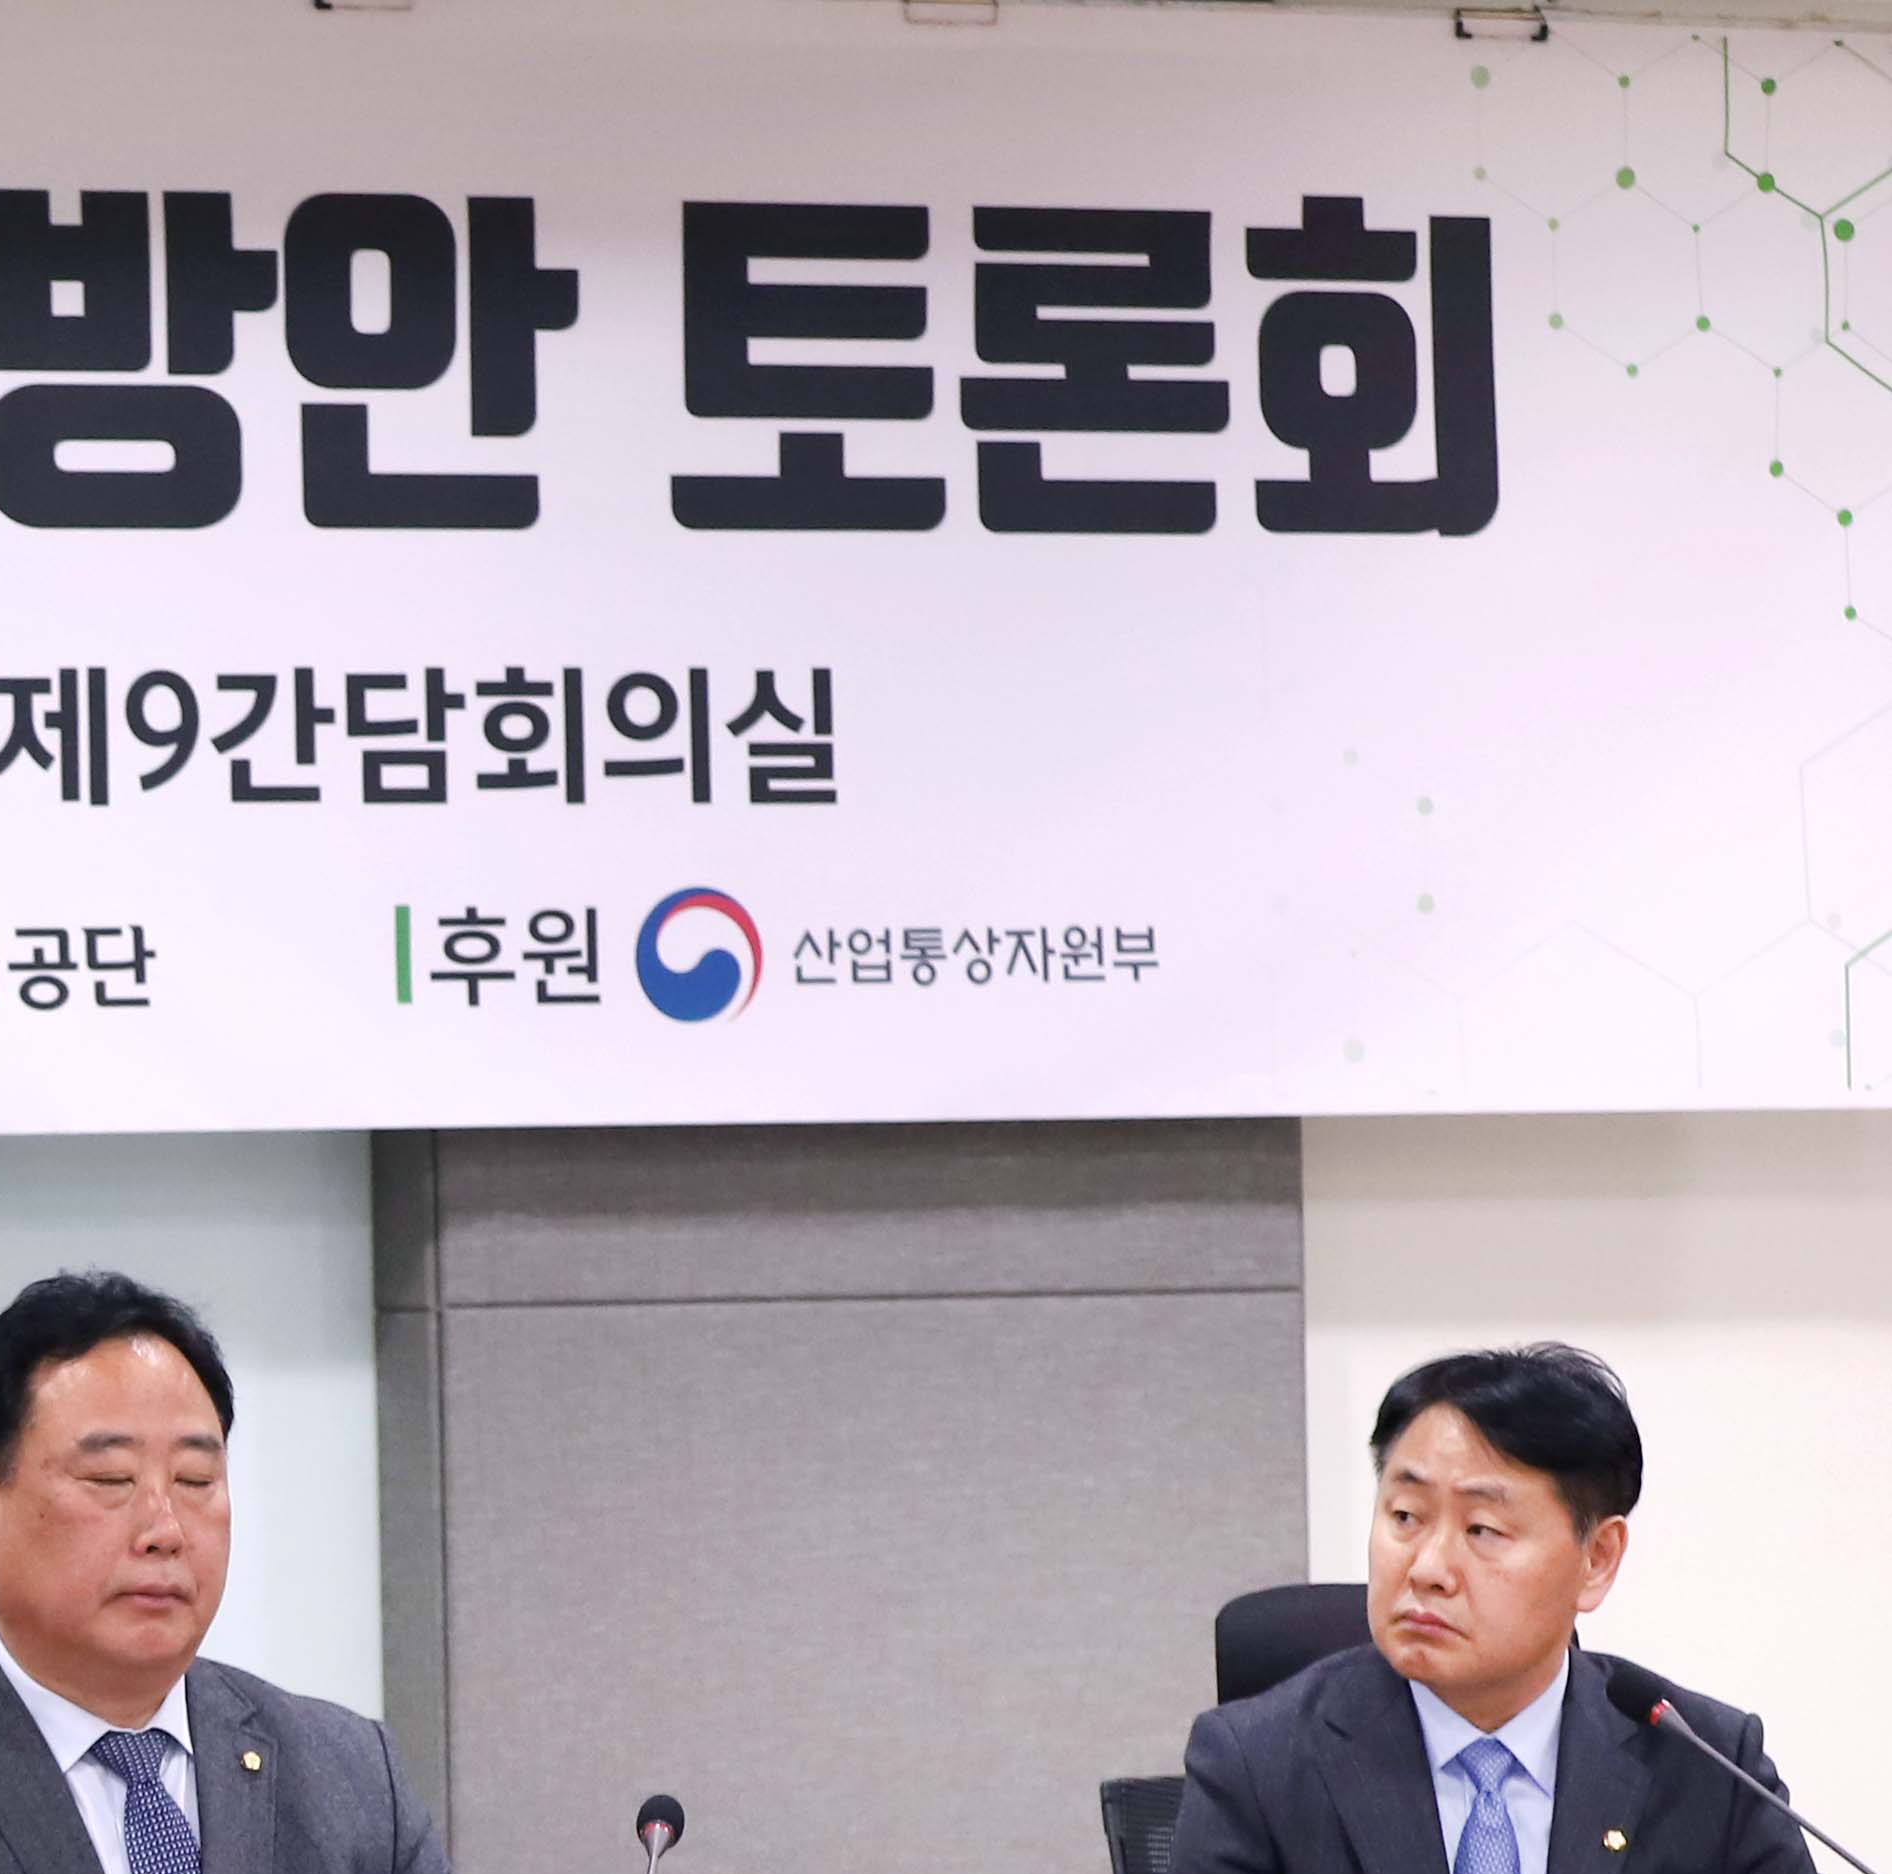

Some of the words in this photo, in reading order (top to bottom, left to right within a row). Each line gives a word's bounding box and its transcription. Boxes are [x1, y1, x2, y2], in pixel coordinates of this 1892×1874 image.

[670, 193, 1501, 538] 토론회
[430, 906, 601, 1007] 후원
[793, 926, 1159, 986] 산업통상자원부
